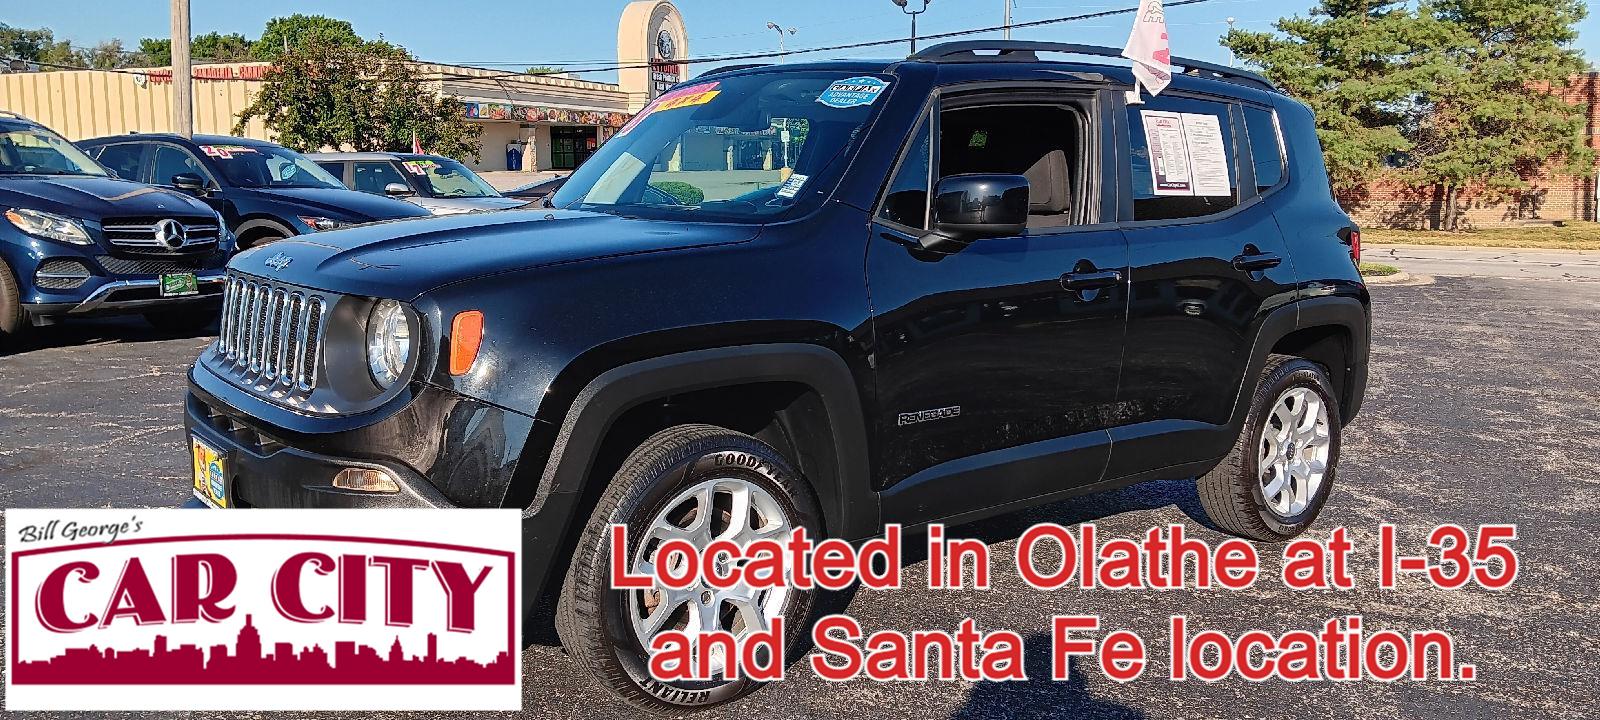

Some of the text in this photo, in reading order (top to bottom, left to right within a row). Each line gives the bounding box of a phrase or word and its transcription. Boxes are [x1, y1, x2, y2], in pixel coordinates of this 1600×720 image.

[827, 91, 870, 99] ADVANTAGE
[830, 84, 878, 93] CARFAX
[897, 406, 960, 426] RENEGADE
[714, 452, 797, 500] GOODYEAR
[638, 675, 711, 704] RELIANT
